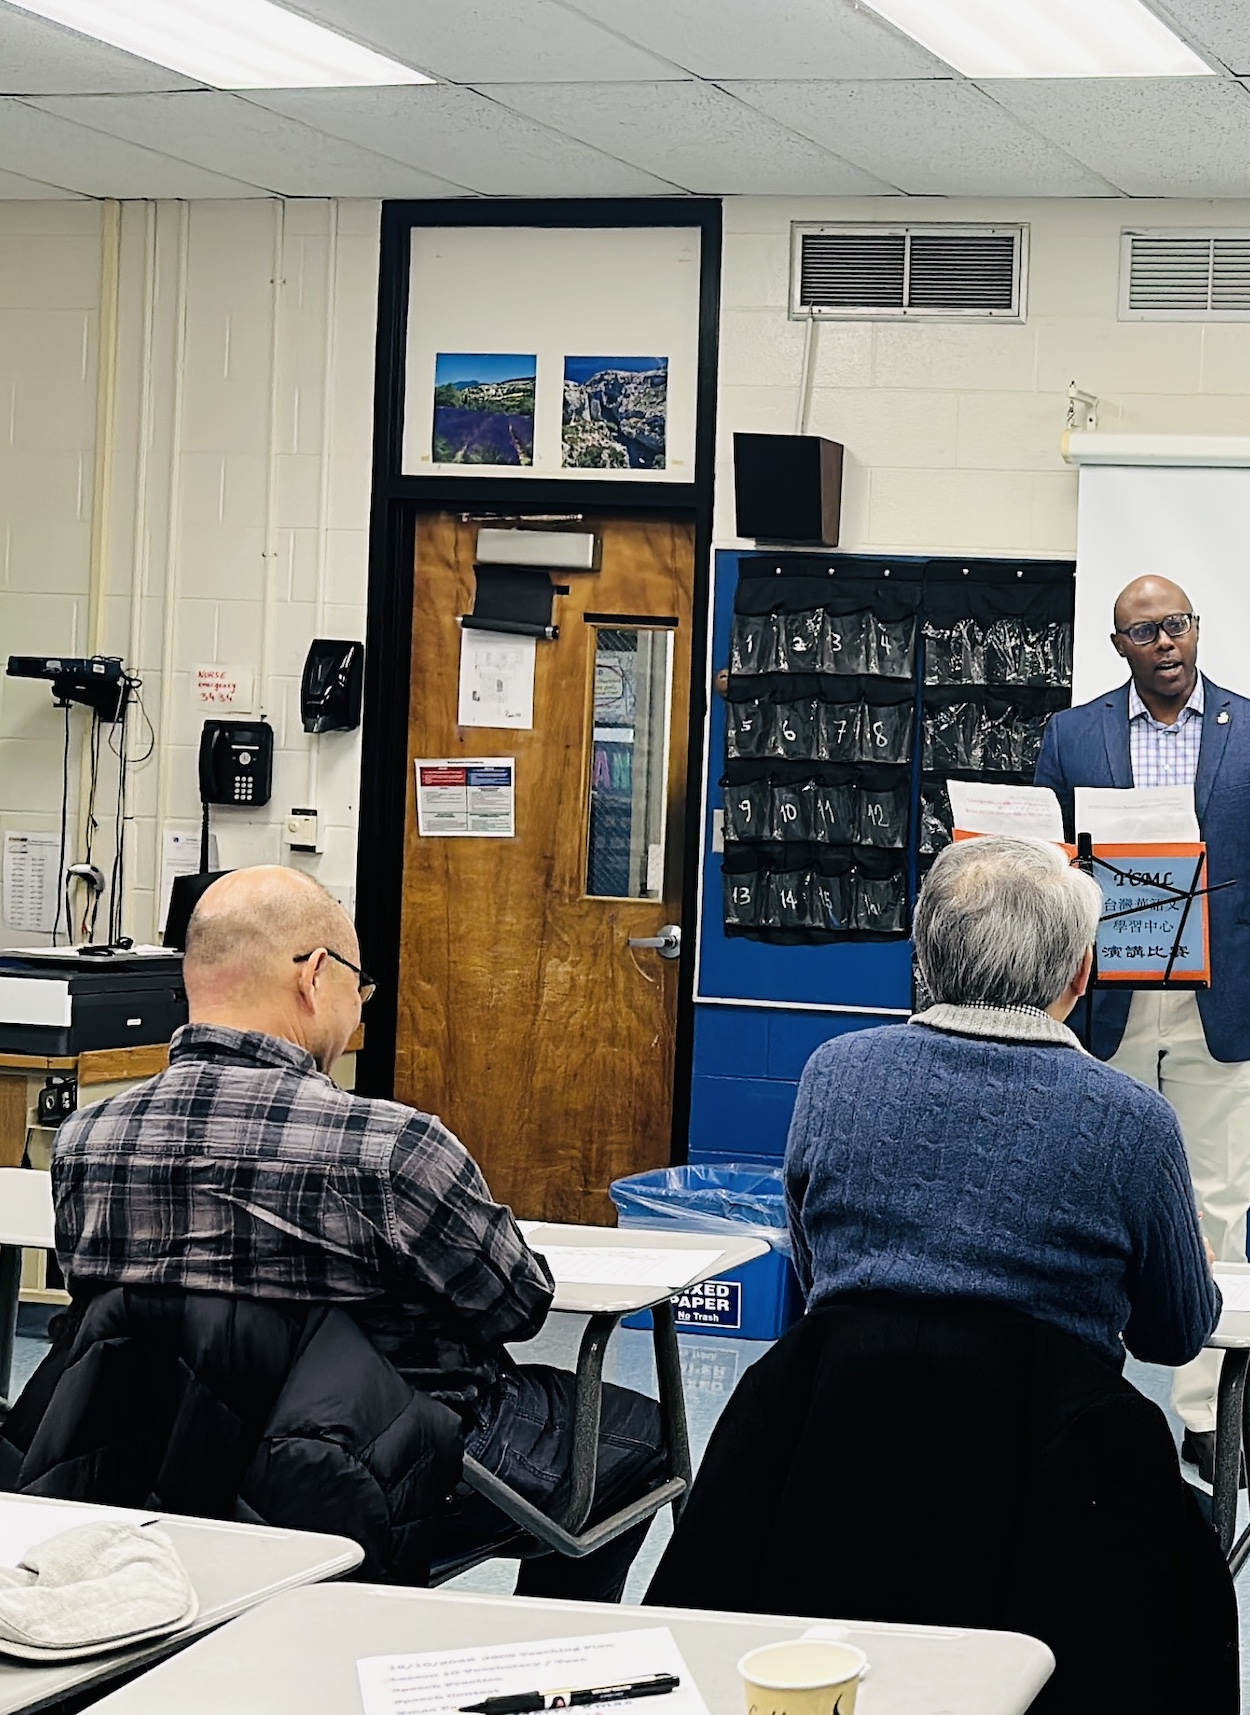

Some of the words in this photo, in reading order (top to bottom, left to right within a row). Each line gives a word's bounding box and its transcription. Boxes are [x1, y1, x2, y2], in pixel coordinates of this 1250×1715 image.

[745, 634, 753, 653] 1
[831, 633, 842, 652] 3
[881, 635, 892, 655] 4
[782, 721, 796, 742] 6
[834, 719, 848, 744] 7
[872, 722, 888, 748] 8
[738, 799, 753, 824] 9
[779, 803, 798, 823] 10
[817, 799, 835, 824] 11
[867, 804, 890, 828] 12
[731, 886, 751, 905] 13
[781, 888, 798, 909] 14
[1113, 919, 1174, 934] 學習中心
[683, 1284, 730, 1297] XED
[670, 1295, 730, 1311] PAPER
[678, 1311, 691, 1320] No
[693, 1312, 719, 1322] Trash
